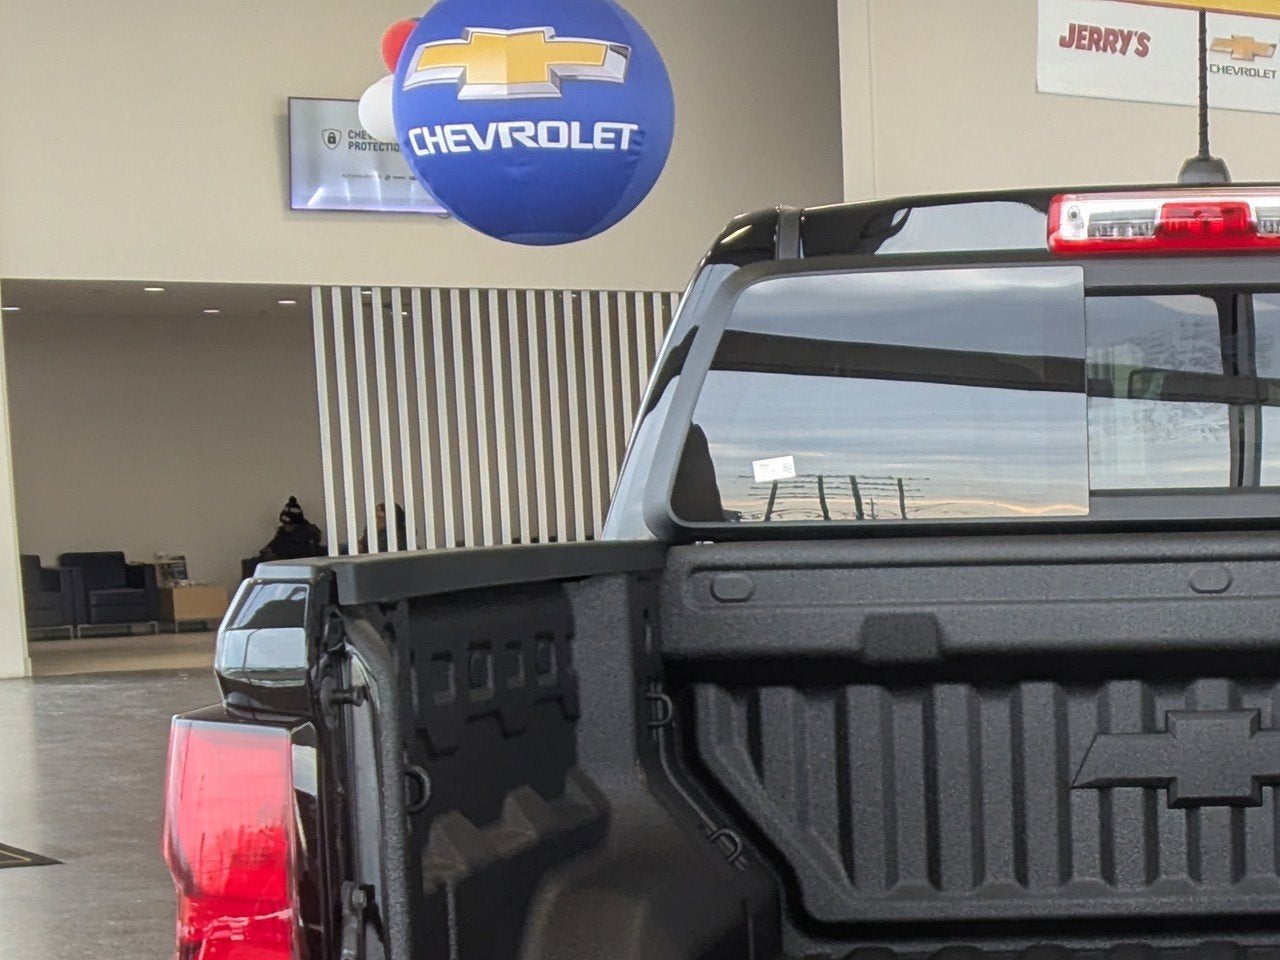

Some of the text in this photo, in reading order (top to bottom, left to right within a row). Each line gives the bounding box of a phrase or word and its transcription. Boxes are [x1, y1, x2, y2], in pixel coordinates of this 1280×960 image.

[1059, 23, 1152, 58] JERRY'S
[1209, 63, 1278, 80] CHEVROLET
[347, 141, 401, 152] PROTECTIO
[408, 120, 639, 157] CHEVROLET
